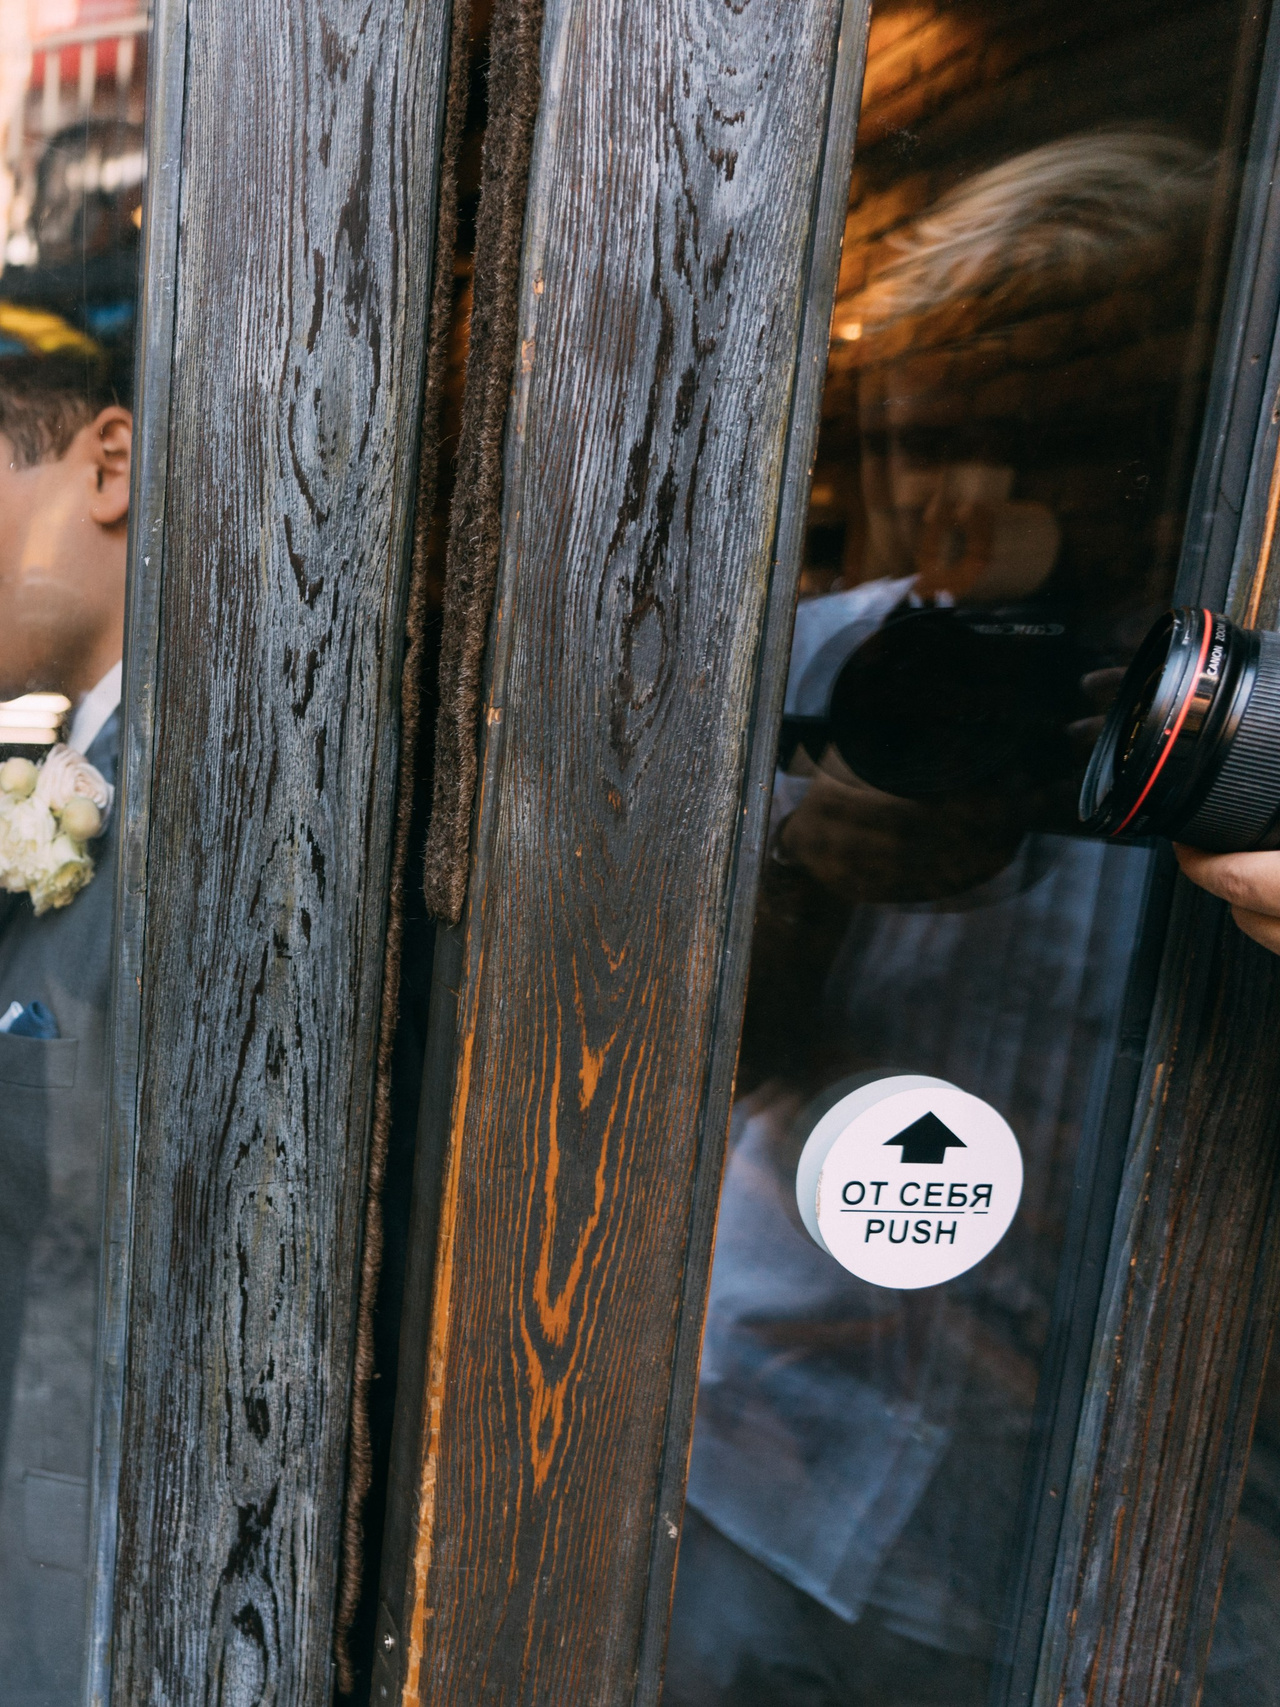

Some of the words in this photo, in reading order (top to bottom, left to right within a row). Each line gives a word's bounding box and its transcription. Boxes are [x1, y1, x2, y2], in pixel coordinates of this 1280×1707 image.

[1215, 622, 1226, 642] ZOOM
[1207, 644, 1224, 676] CANON
[841, 1181, 889, 1206] ОТ
[899, 1182, 993, 1208] СЕБЯ
[864, 1219, 957, 1245] PUSH
